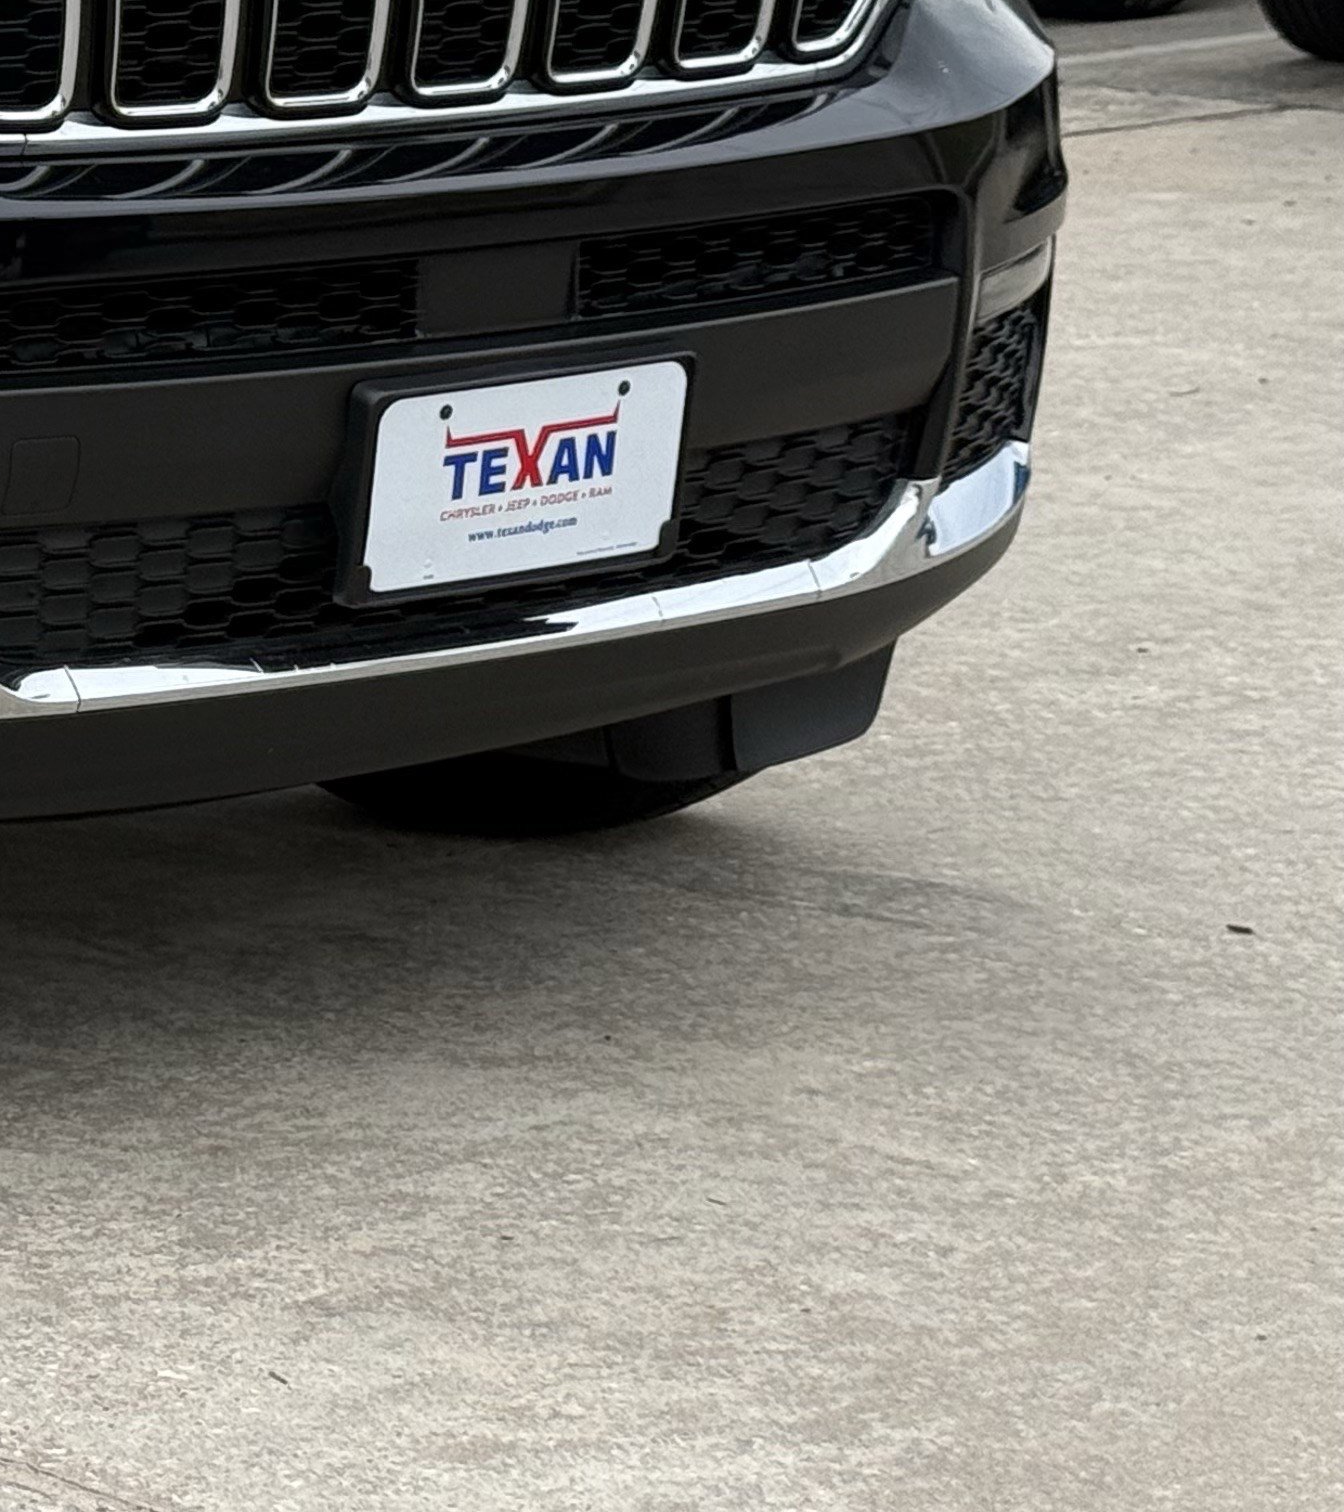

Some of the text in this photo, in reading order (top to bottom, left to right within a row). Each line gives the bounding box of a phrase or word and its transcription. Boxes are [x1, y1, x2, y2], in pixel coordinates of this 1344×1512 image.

[442, 428, 617, 502] TEXAN
[439, 486, 613, 522] CHRYSLER JEEP DODGE RAM
[467, 515, 578, 542] www.texandodge.com
